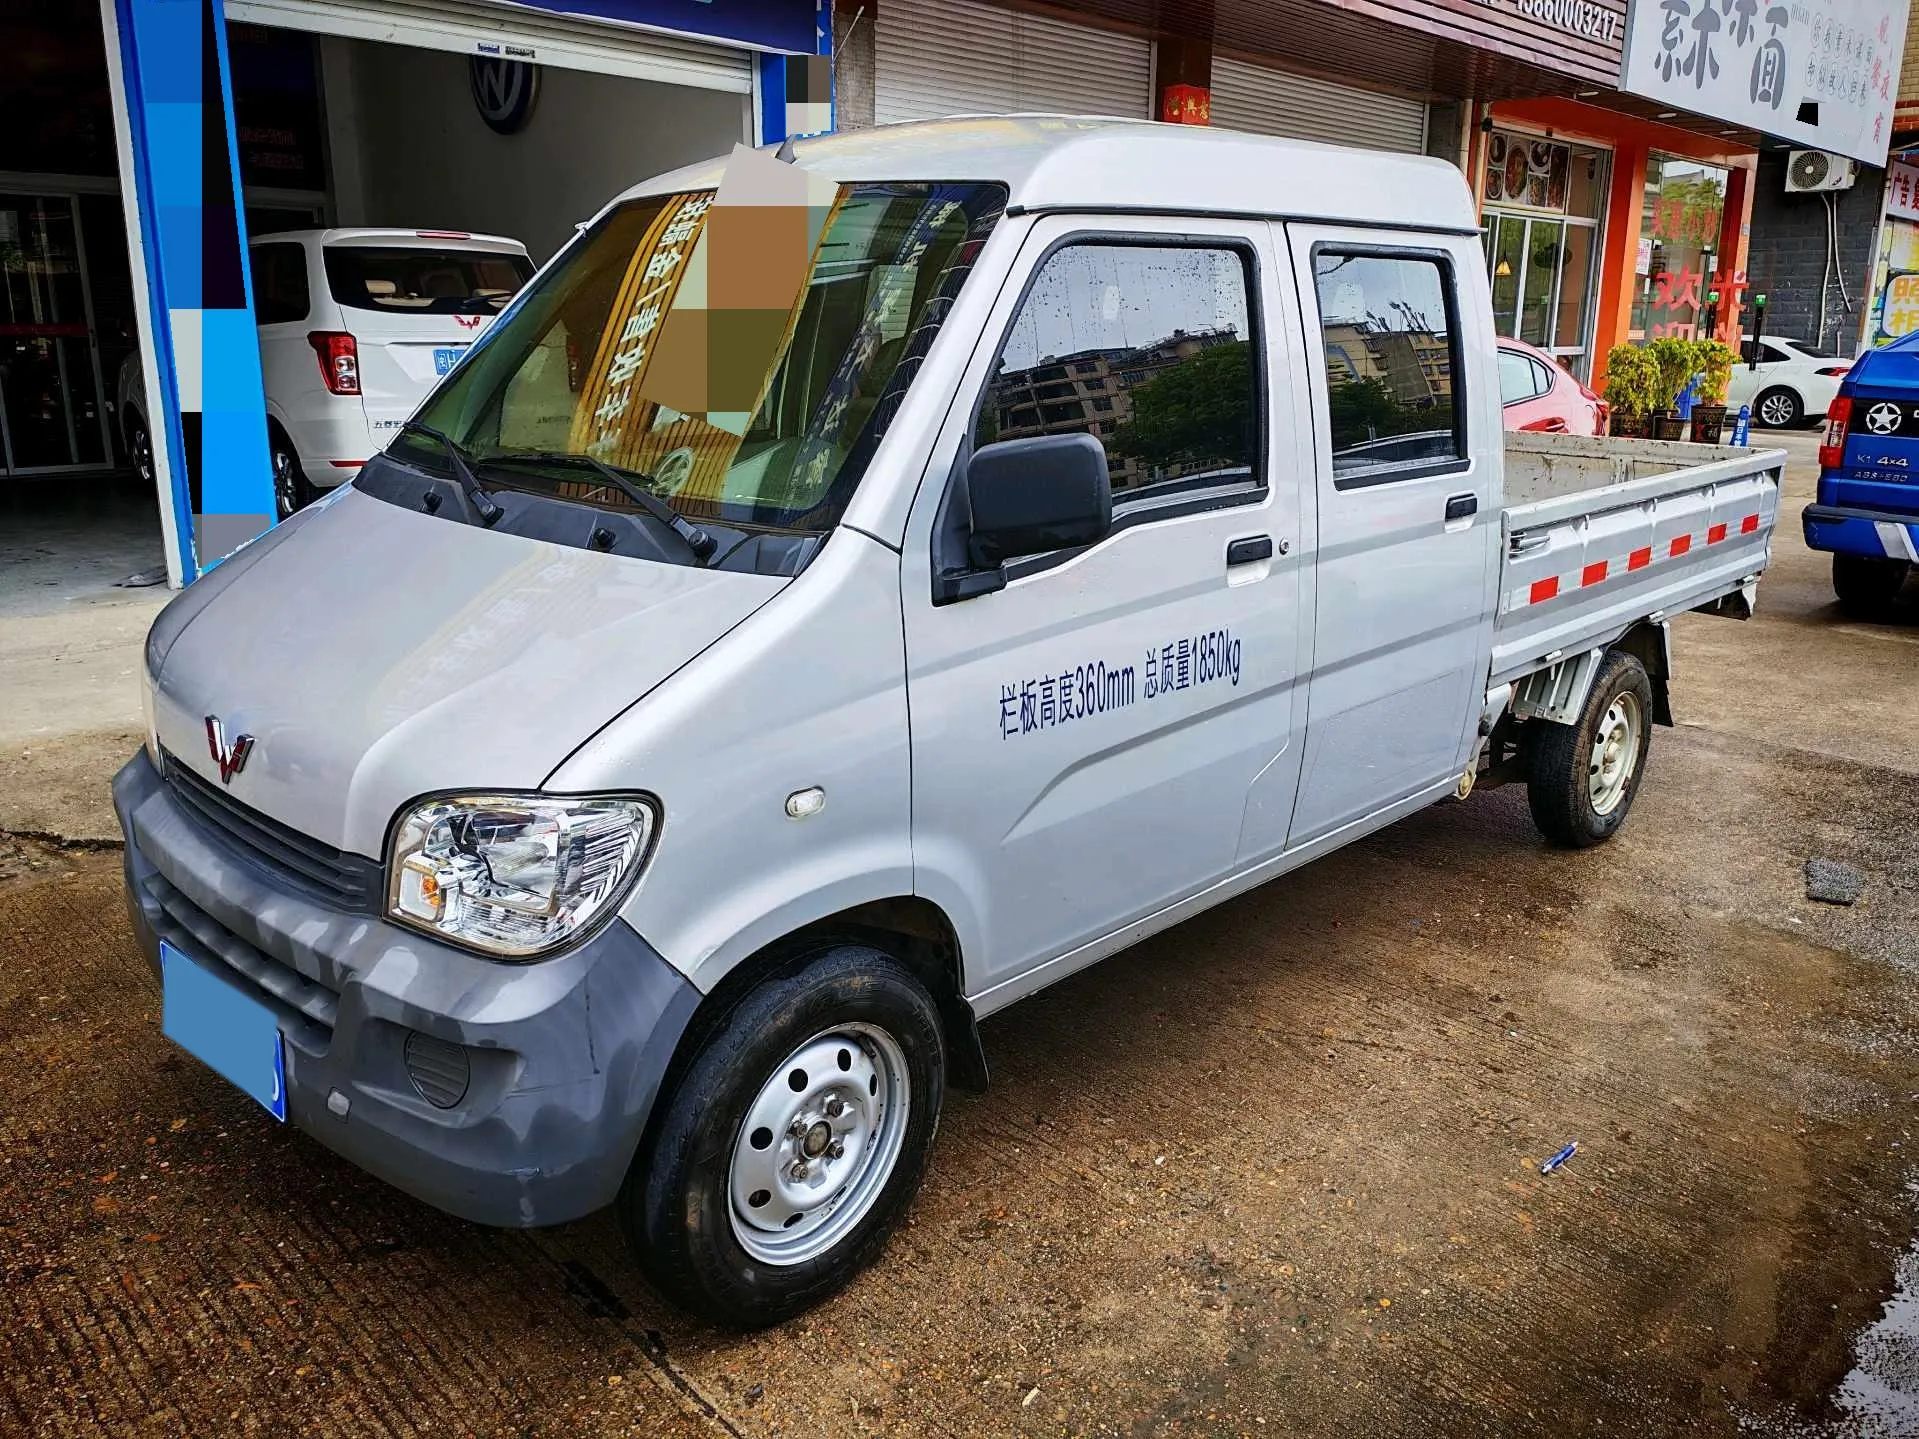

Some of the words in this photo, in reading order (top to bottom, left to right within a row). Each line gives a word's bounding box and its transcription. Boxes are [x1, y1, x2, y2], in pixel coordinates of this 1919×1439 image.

[999, 660, 1135, 741] 栏板高度360mm
[1143, 627, 1241, 699] 总质量1850kg
